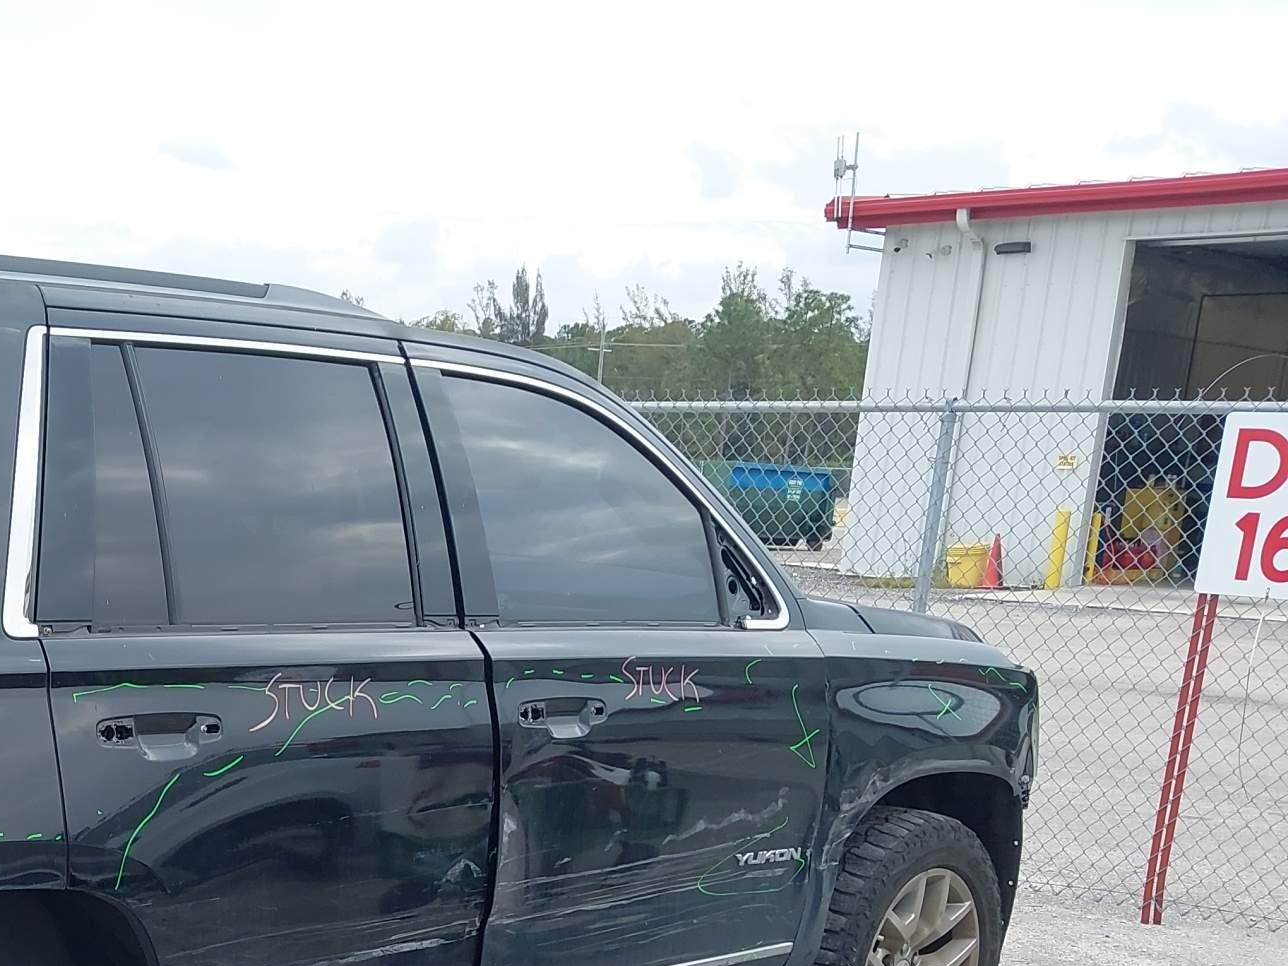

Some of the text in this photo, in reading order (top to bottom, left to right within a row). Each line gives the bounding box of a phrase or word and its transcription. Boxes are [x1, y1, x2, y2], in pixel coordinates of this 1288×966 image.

[249, 673, 378, 732] STUCK
[621, 656, 701, 703] STUCK
[735, 847, 802, 866] YUKON
